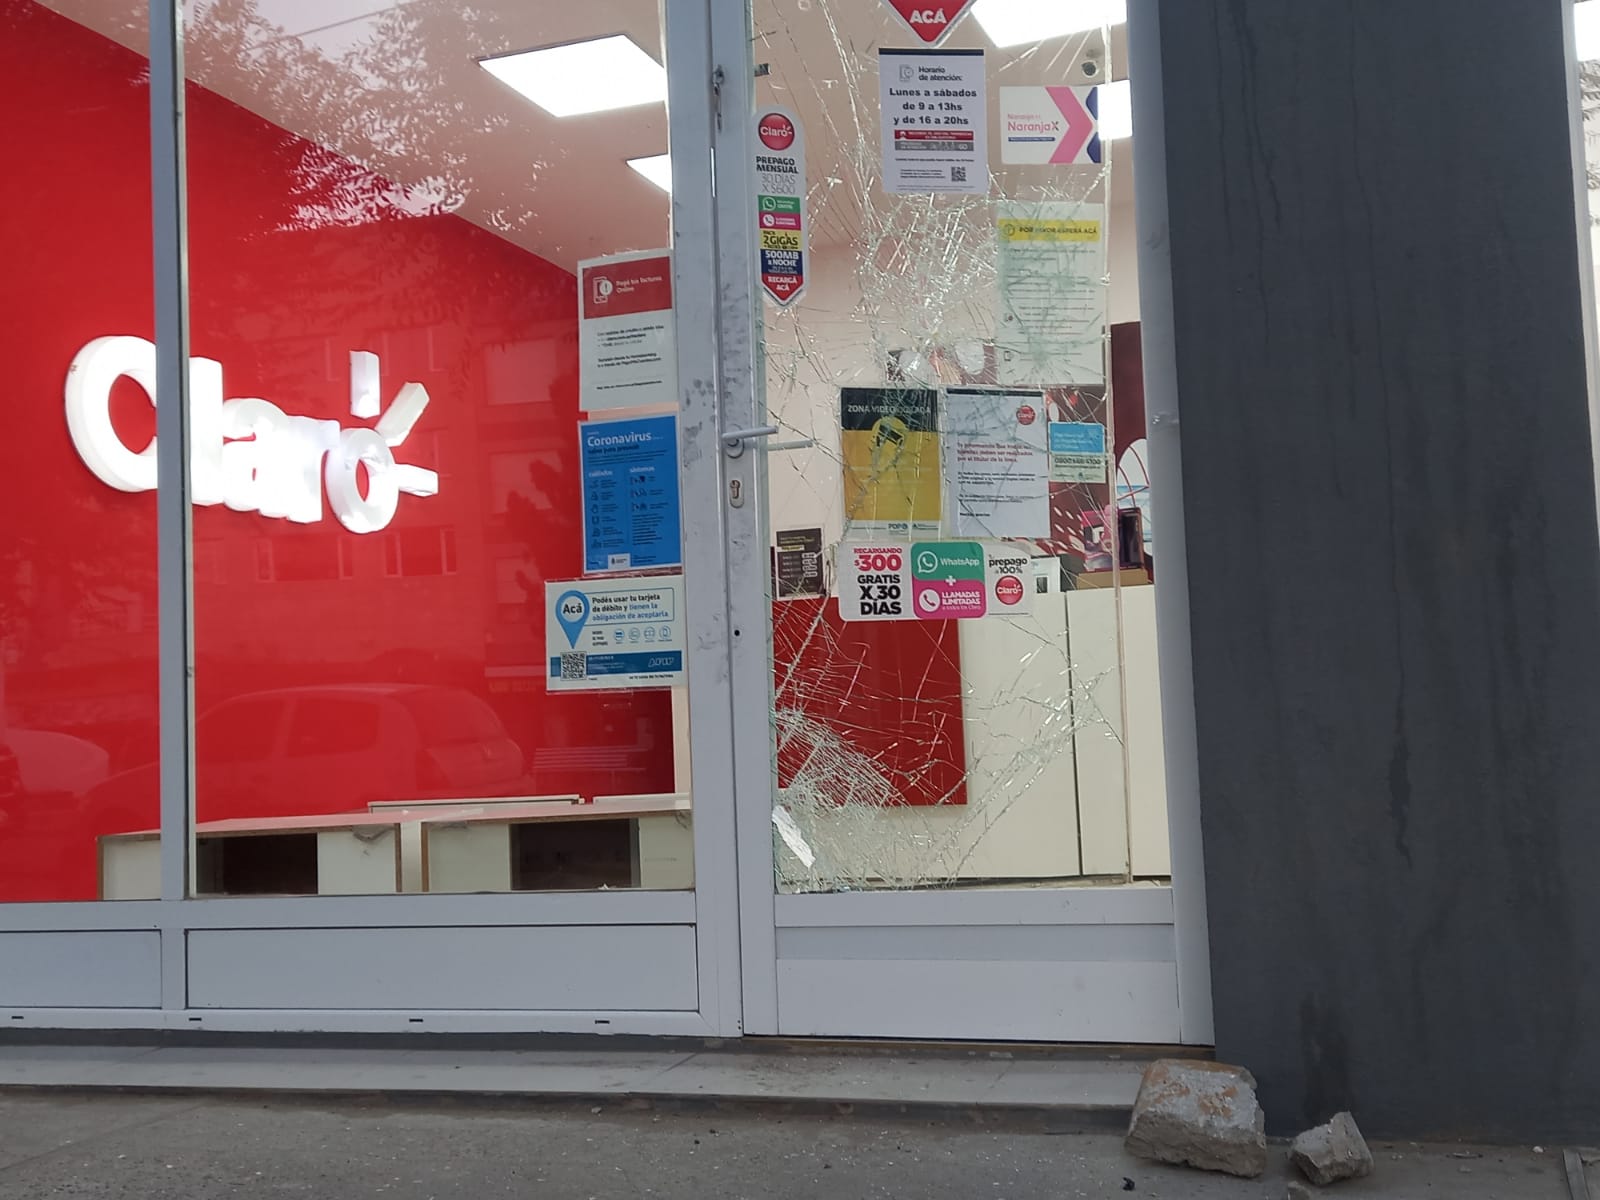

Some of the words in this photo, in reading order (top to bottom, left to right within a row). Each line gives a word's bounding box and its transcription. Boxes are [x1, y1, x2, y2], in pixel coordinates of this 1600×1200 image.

[910, 8, 948, 24] ACÁ
[918, 66, 946, 74] Horario
[889, 87, 921, 96] Lunes
[924, 89, 931, 97] a
[933, 87, 977, 97] sábados
[902, 102, 916, 111] de
[918, 102, 925, 111] 9
[938, 102, 963, 111] 13hs
[893, 117, 900, 126] y
[902, 116, 916, 124] de
[918, 116, 932, 125] 16
[934, 117, 941, 125] a
[943, 116, 969, 125] 20hs
[759, 124, 793, 138] Claro
[755, 155, 796, 166] PREPAGO
[756, 164, 800, 175] MENSUAL
[764, 249, 800, 260] 500MB
[767, 275, 798, 284] RECARGÁ
[776, 283, 790, 292] ACÁ
[848, 404, 871, 413] ZONA
[65, 335, 438, 533] Claro
[587, 431, 652, 447] Coronavirus
[940, 557, 980, 567] WhatsApp
[988, 557, 1028, 568] prepago
[857, 574, 901, 584] GRATIS
[860, 585, 874, 600] X
[876, 584, 901, 600] 30
[996, 584, 1022, 595] Claro
[591, 596, 612, 604] Podés
[613, 595, 628, 603] usar
[638, 594, 661, 603] tarjeta
[562, 602, 583, 615] Acá
[601, 604, 623, 612] débito
